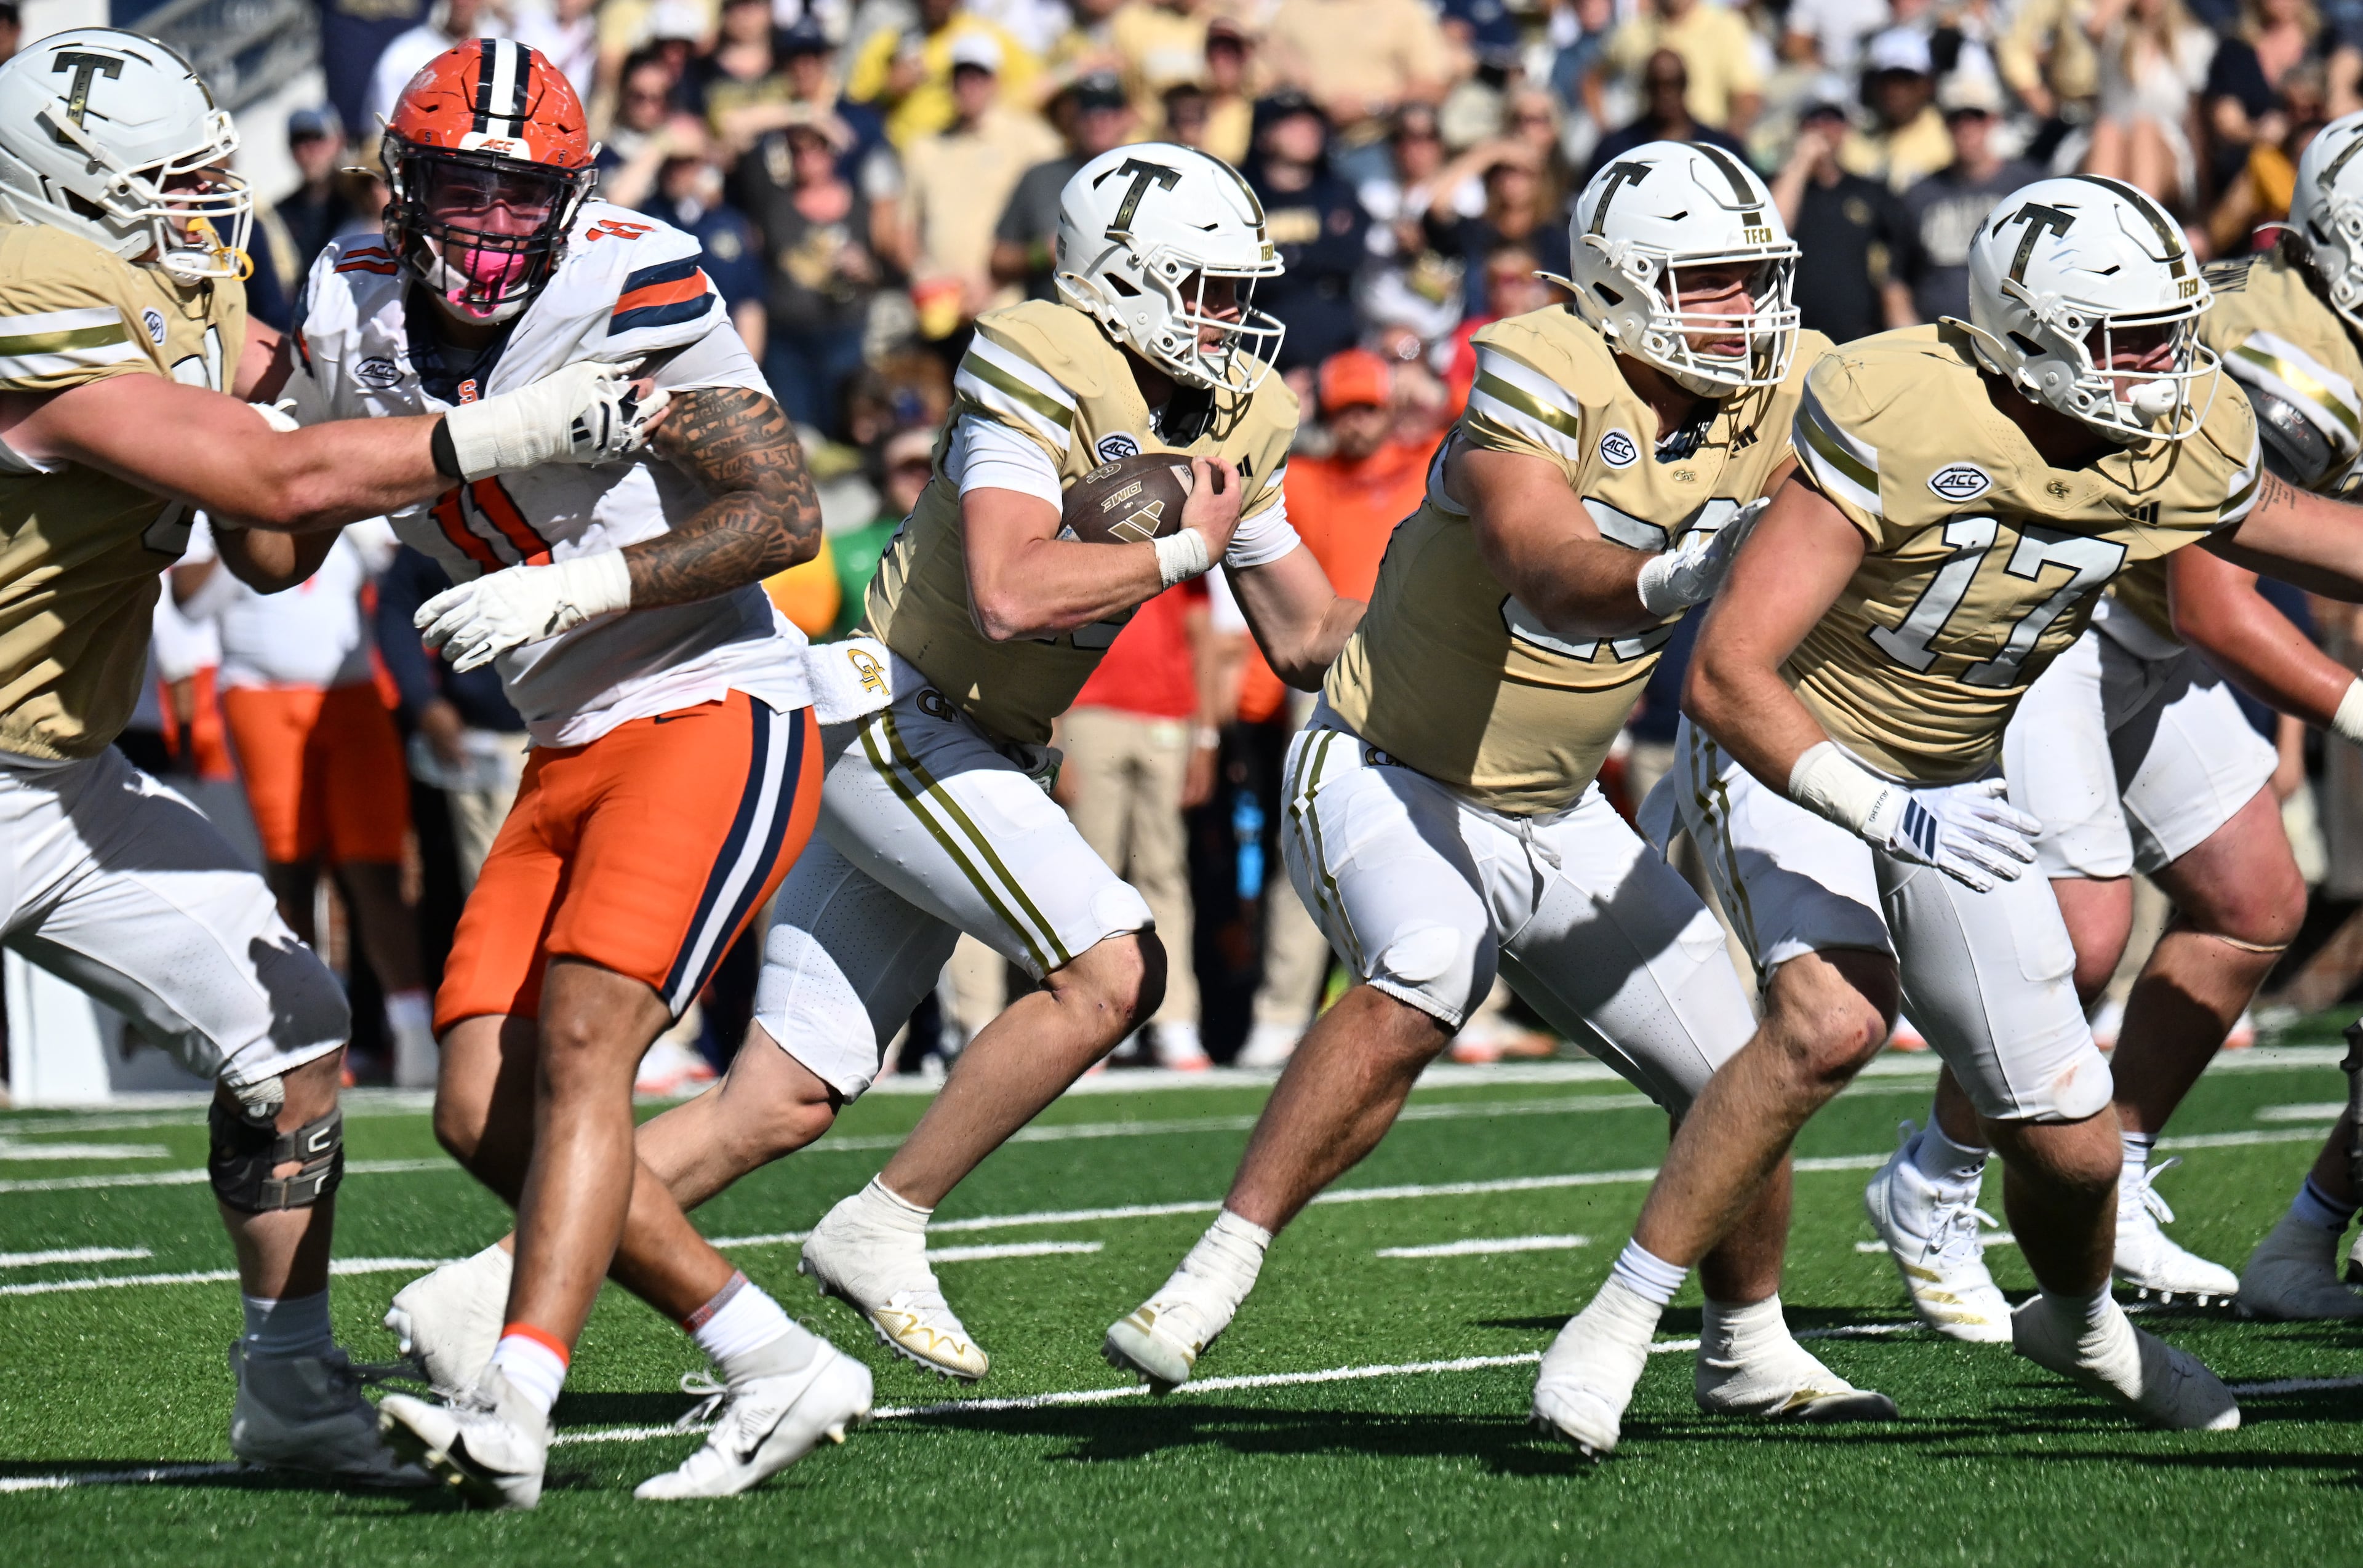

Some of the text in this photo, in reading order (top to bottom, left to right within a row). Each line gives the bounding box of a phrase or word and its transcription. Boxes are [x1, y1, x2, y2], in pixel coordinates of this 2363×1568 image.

[71, 70, 87, 118] TECH
[424, 132, 432, 142] S
[479, 138, 516, 151] ACC
[1121, 177, 1145, 219] TECH
[1743, 228, 1772, 245] TECH
[2016, 225, 2038, 272] TECH
[362, 363, 397, 377] ACC
[458, 378, 478, 405] S
[1102, 441, 1135, 457] ACC
[1604, 439, 1631, 457] ACC
[1940, 474, 1980, 486] ACC
[1100, 481, 1143, 514] DIME
[1865, 513, 2129, 689] 17
[1868, 789, 1889, 823] ADIZERO
